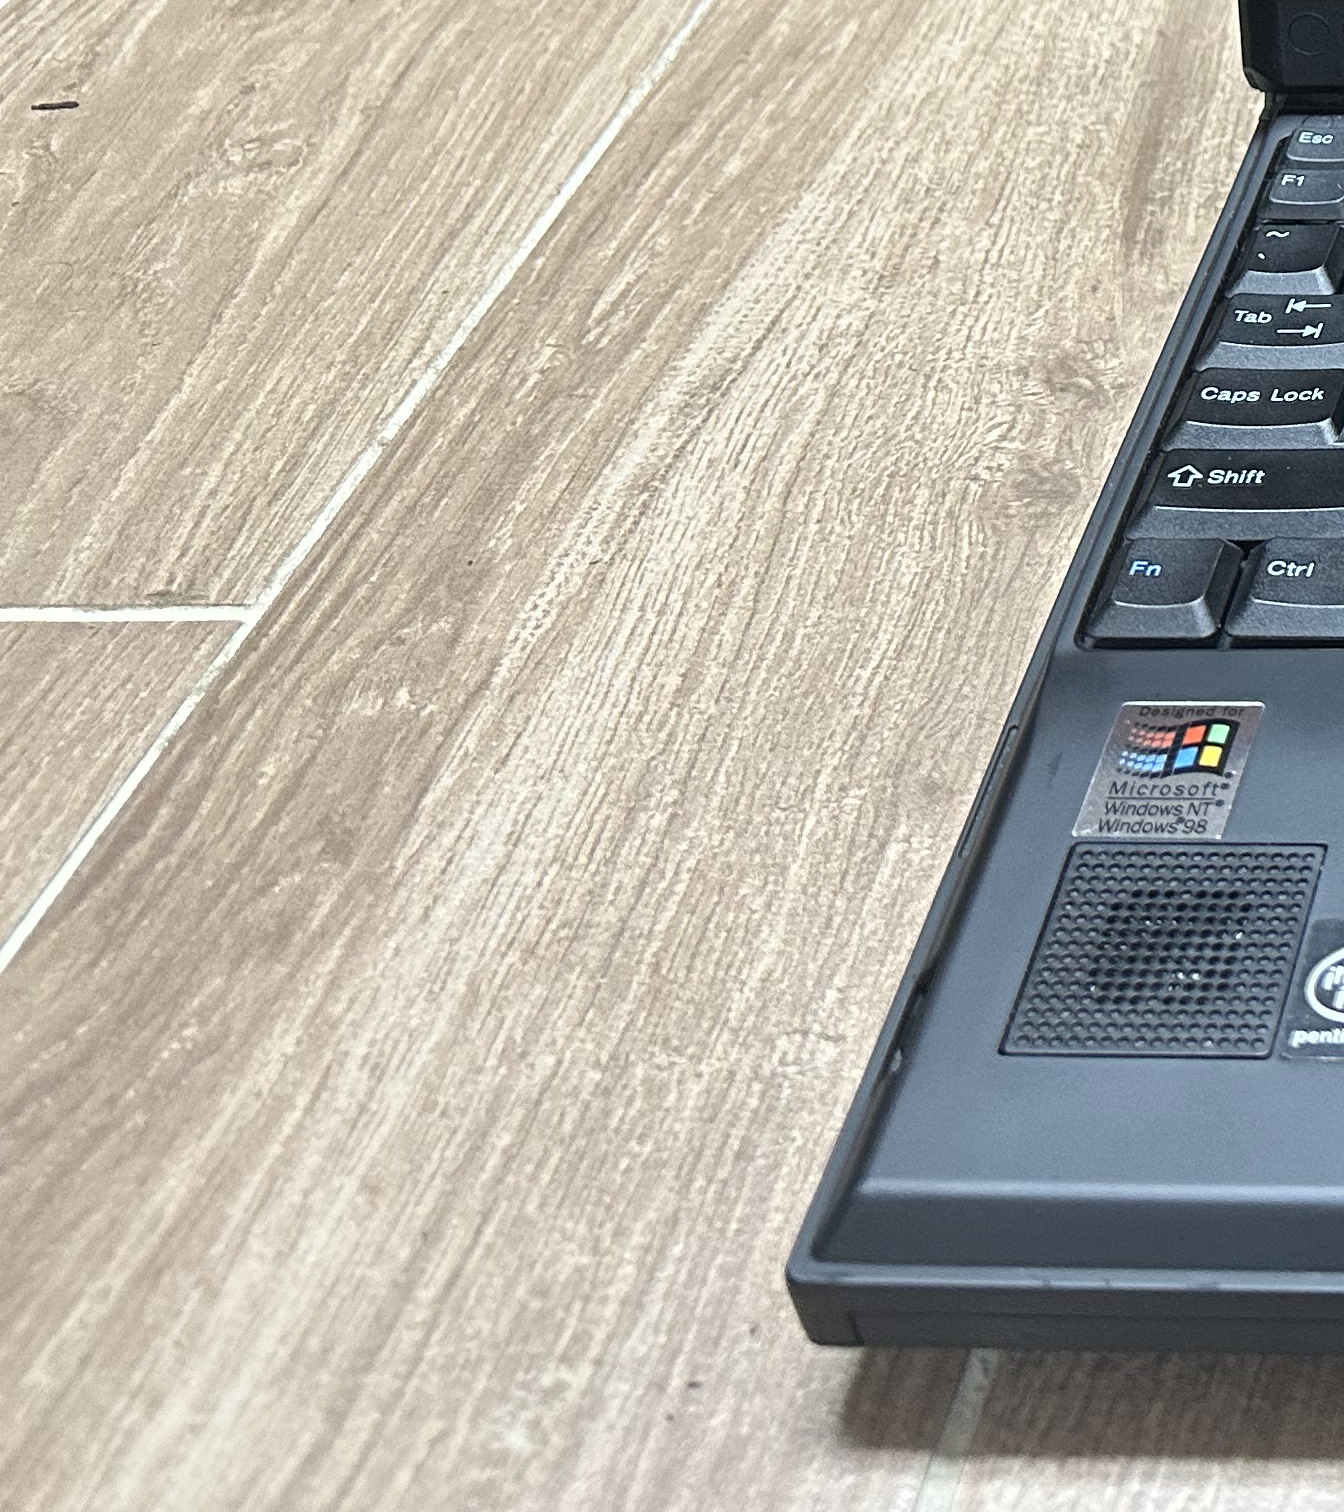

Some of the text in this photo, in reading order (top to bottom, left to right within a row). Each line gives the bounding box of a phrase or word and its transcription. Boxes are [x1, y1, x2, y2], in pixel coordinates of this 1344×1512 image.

[1299, 132, 1333, 144] Esc
[1281, 175, 1305, 186] F1
[1234, 309, 1272, 324] Tab
[1200, 387, 1324, 404] Caps Lock
[1207, 469, 1265, 485] Shift
[1128, 561, 1161, 577] Fn
[1266, 560, 1314, 578] Ctrl
[1139, 706, 1245, 718] Designed for
[1105, 802, 1183, 816] Windows
[1182, 819, 1208, 834] 98
